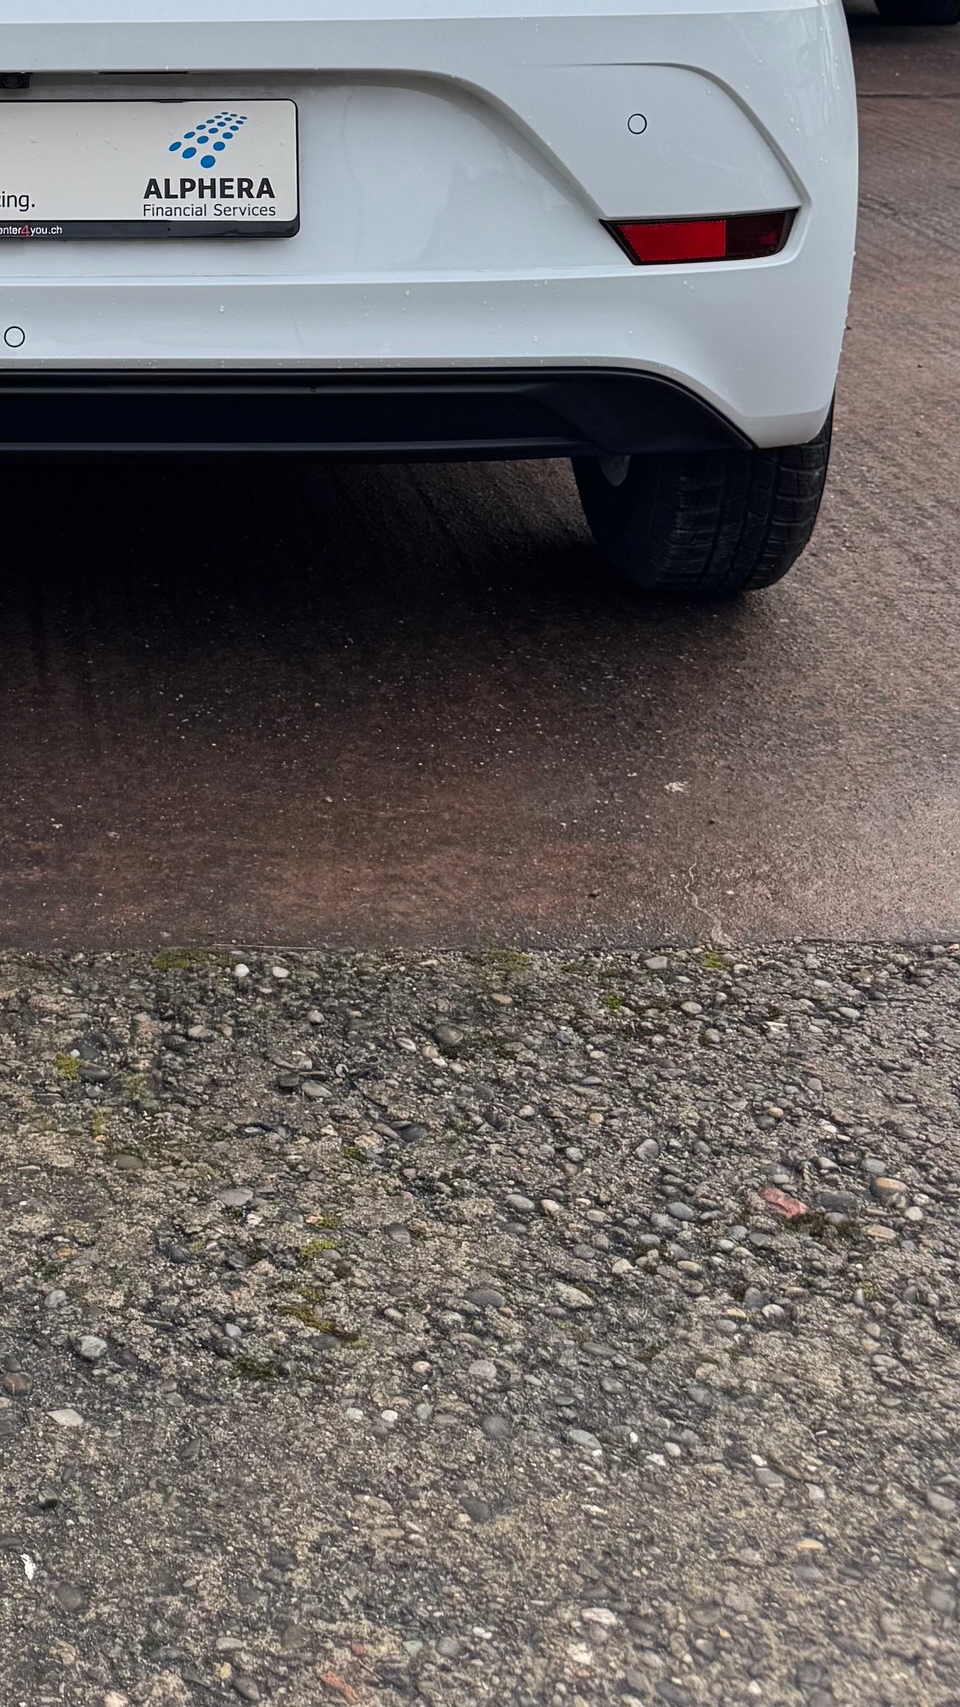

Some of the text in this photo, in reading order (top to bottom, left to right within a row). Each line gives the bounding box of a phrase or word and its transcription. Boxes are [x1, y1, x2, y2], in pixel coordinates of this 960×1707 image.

[143, 178, 276, 199] ALPHERA
[143, 204, 276, 217] Financial Services
